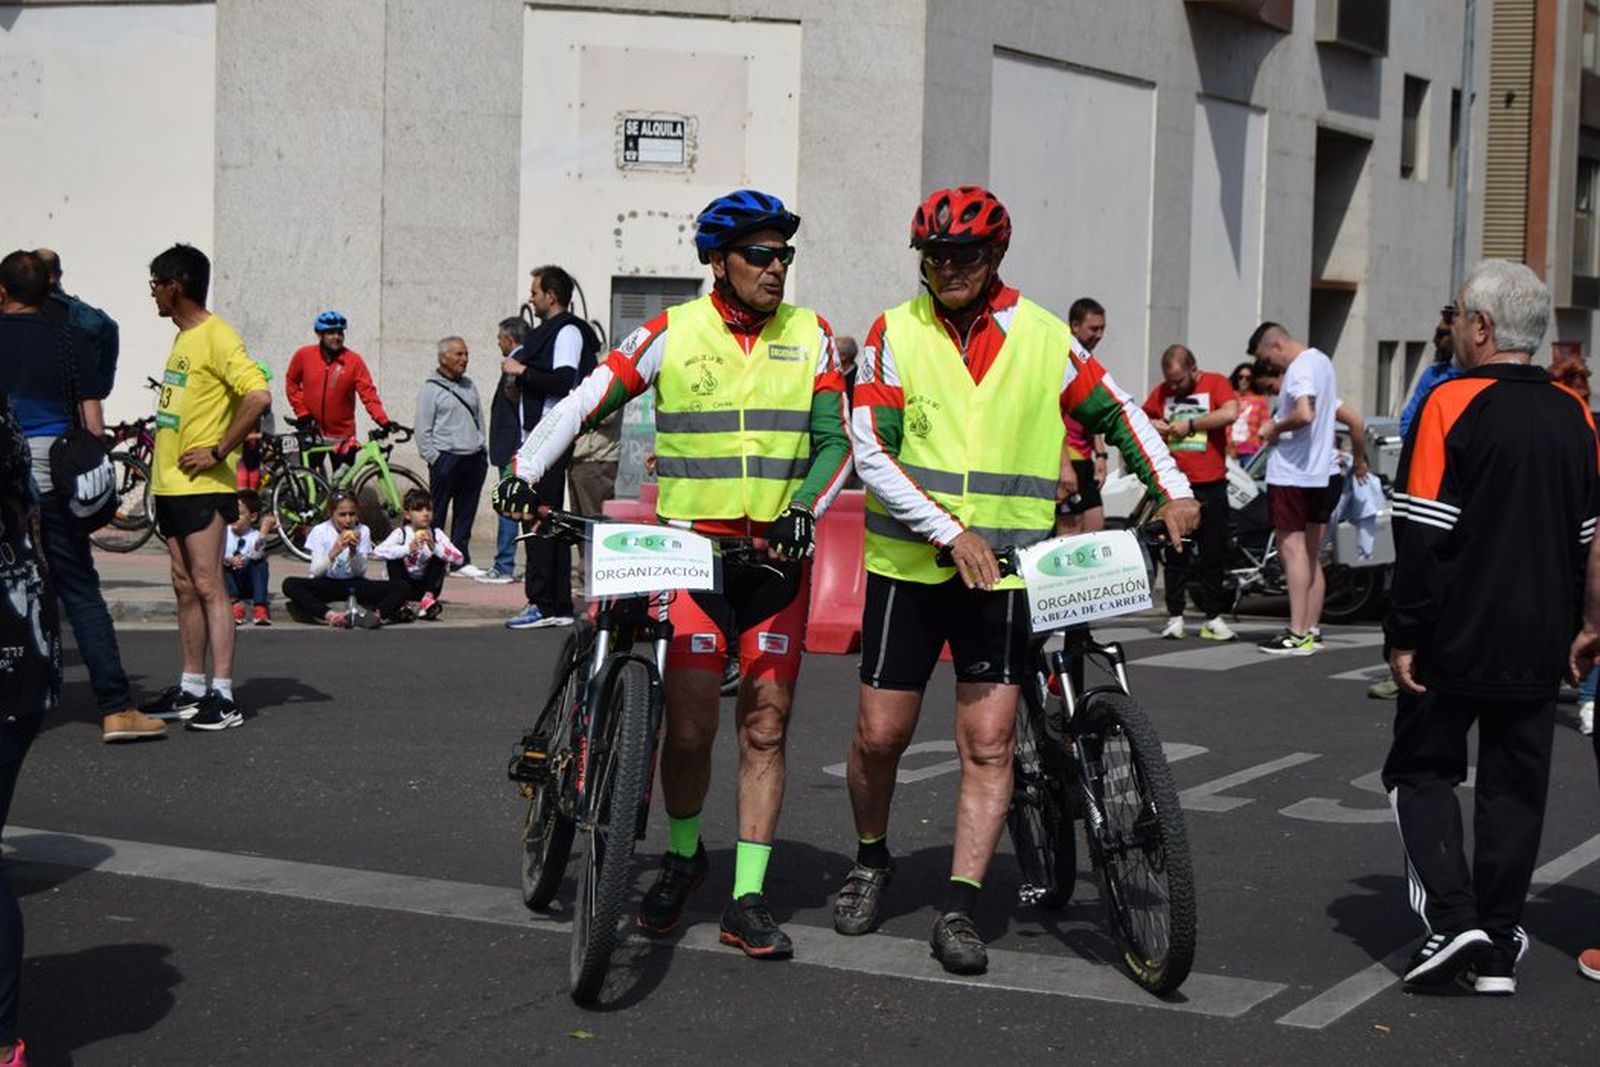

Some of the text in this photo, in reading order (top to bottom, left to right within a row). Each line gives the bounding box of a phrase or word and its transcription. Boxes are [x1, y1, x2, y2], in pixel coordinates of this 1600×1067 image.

[626, 120, 683, 137] SE ALQUILA
[595, 566, 710, 581] ORGANIZACIÓN
[1037, 578, 1146, 611] ORGANIZACIÓN
[1032, 608, 1078, 625] CABEZA
[1081, 603, 1098, 616] DE
